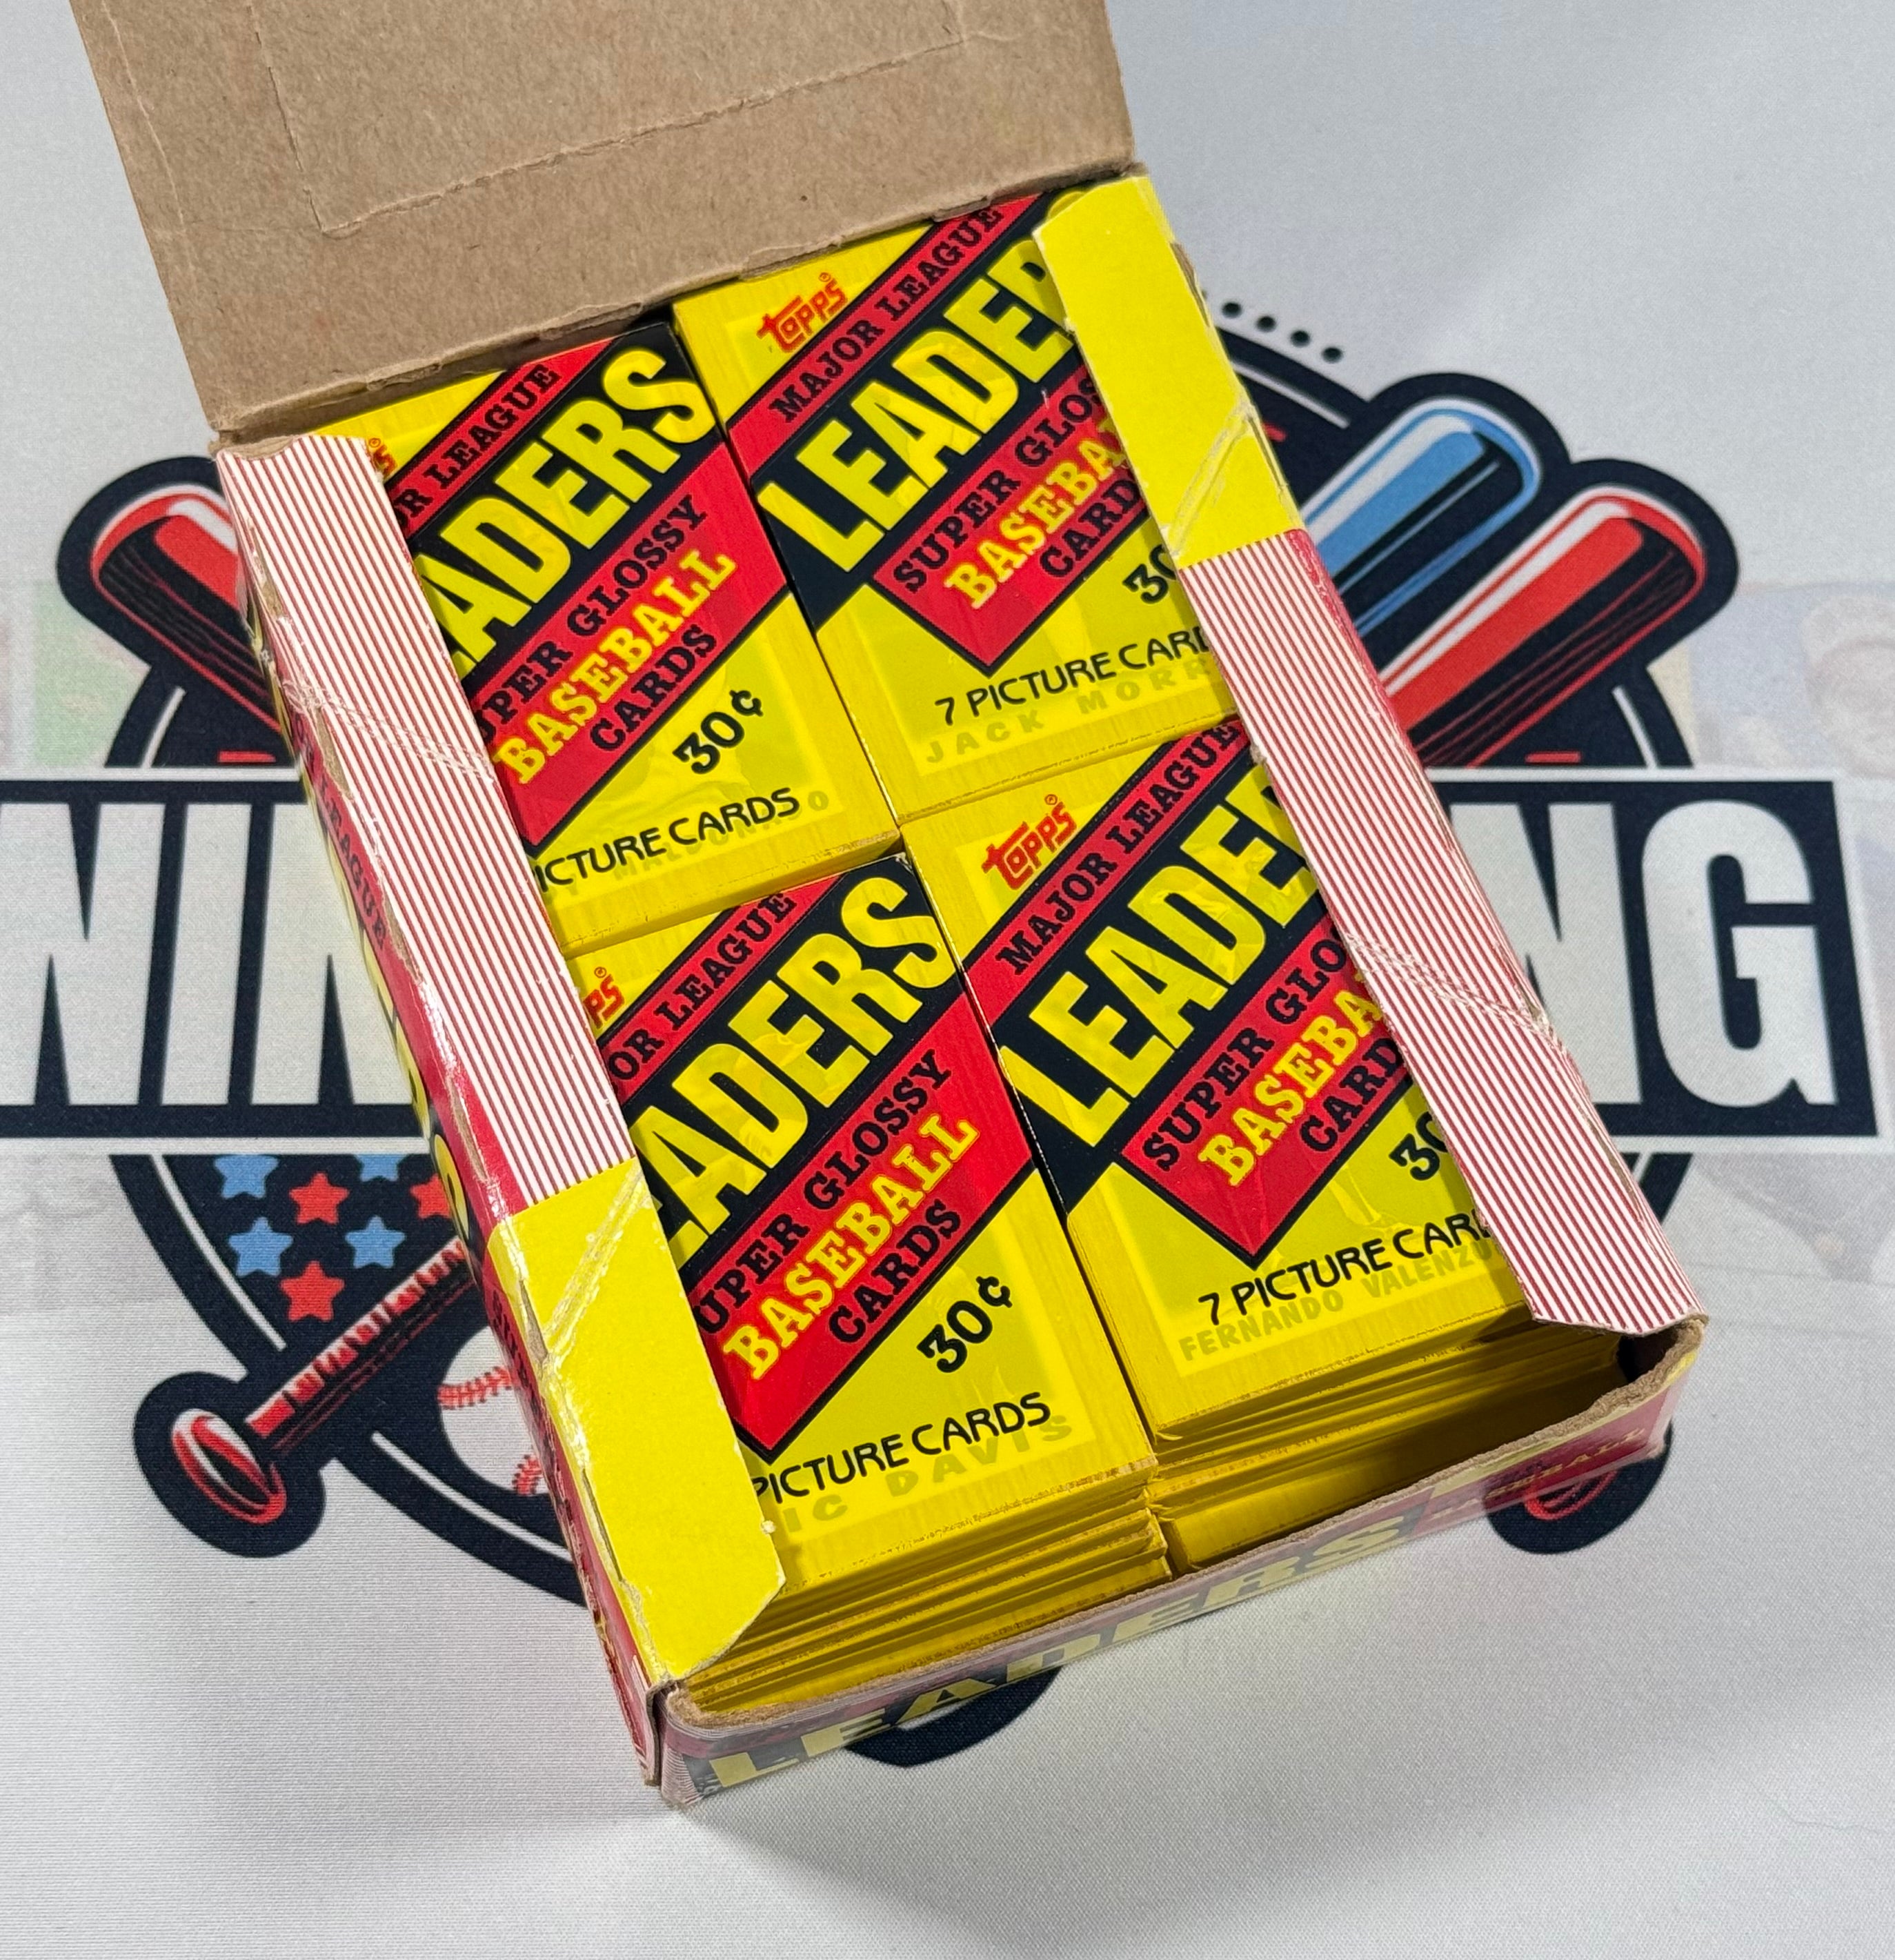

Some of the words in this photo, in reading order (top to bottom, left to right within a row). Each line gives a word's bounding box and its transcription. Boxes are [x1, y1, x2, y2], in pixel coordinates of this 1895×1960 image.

[768, 319, 884, 424] MAJOR
[879, 207, 1005, 321] LEAGUE
[421, 364, 562, 490] LEAGUE
[413, 349, 716, 680] ADERS
[893, 470, 1021, 593] SUPER
[944, 419, 1129, 609] BASEBA
[1040, 477, 1141, 579] CARD
[475, 640, 574, 745] UPER
[567, 495, 707, 637] GLOSSY
[493, 550, 738, 785] BASEBALL
[588, 623, 717, 751] CARDS
[673, 689, 764, 775] 30¢
[926, 709, 1044, 763] JACK
[934, 696, 956, 726] 7
[966, 651, 1118, 717] PICTURE
[533, 826, 667, 893] ICTURE
[668, 786, 800, 846] CARDS
[995, 850, 1118, 976] MAJOR
[1105, 722, 1240, 853] LEAGUE
[656, 893, 797, 1032] LEAGUE
[629, 876, 957, 1271] ADERS
[1142, 1027, 1275, 1171] SUPER
[1265, 937, 1346, 1024] GLO
[1198, 988, 1383, 1187] BASEBA
[1302, 1037, 1405, 1152] CARD
[692, 1213, 811, 1334] UPER
[803, 1049, 951, 1211] GLOSSY
[723, 1112, 980, 1380] BASEBALL
[828, 1198, 962, 1344] CARDS
[917, 1275, 1013, 1373] 30¢
[1178, 1290, 1345, 1362] FERNANDO
[1360, 1242, 1493, 1298] VALENZU
[1198, 1291, 1220, 1325] 7
[1230, 1238, 1393, 1316] PICTURE
[911, 1392, 1052, 1456] CARDS
